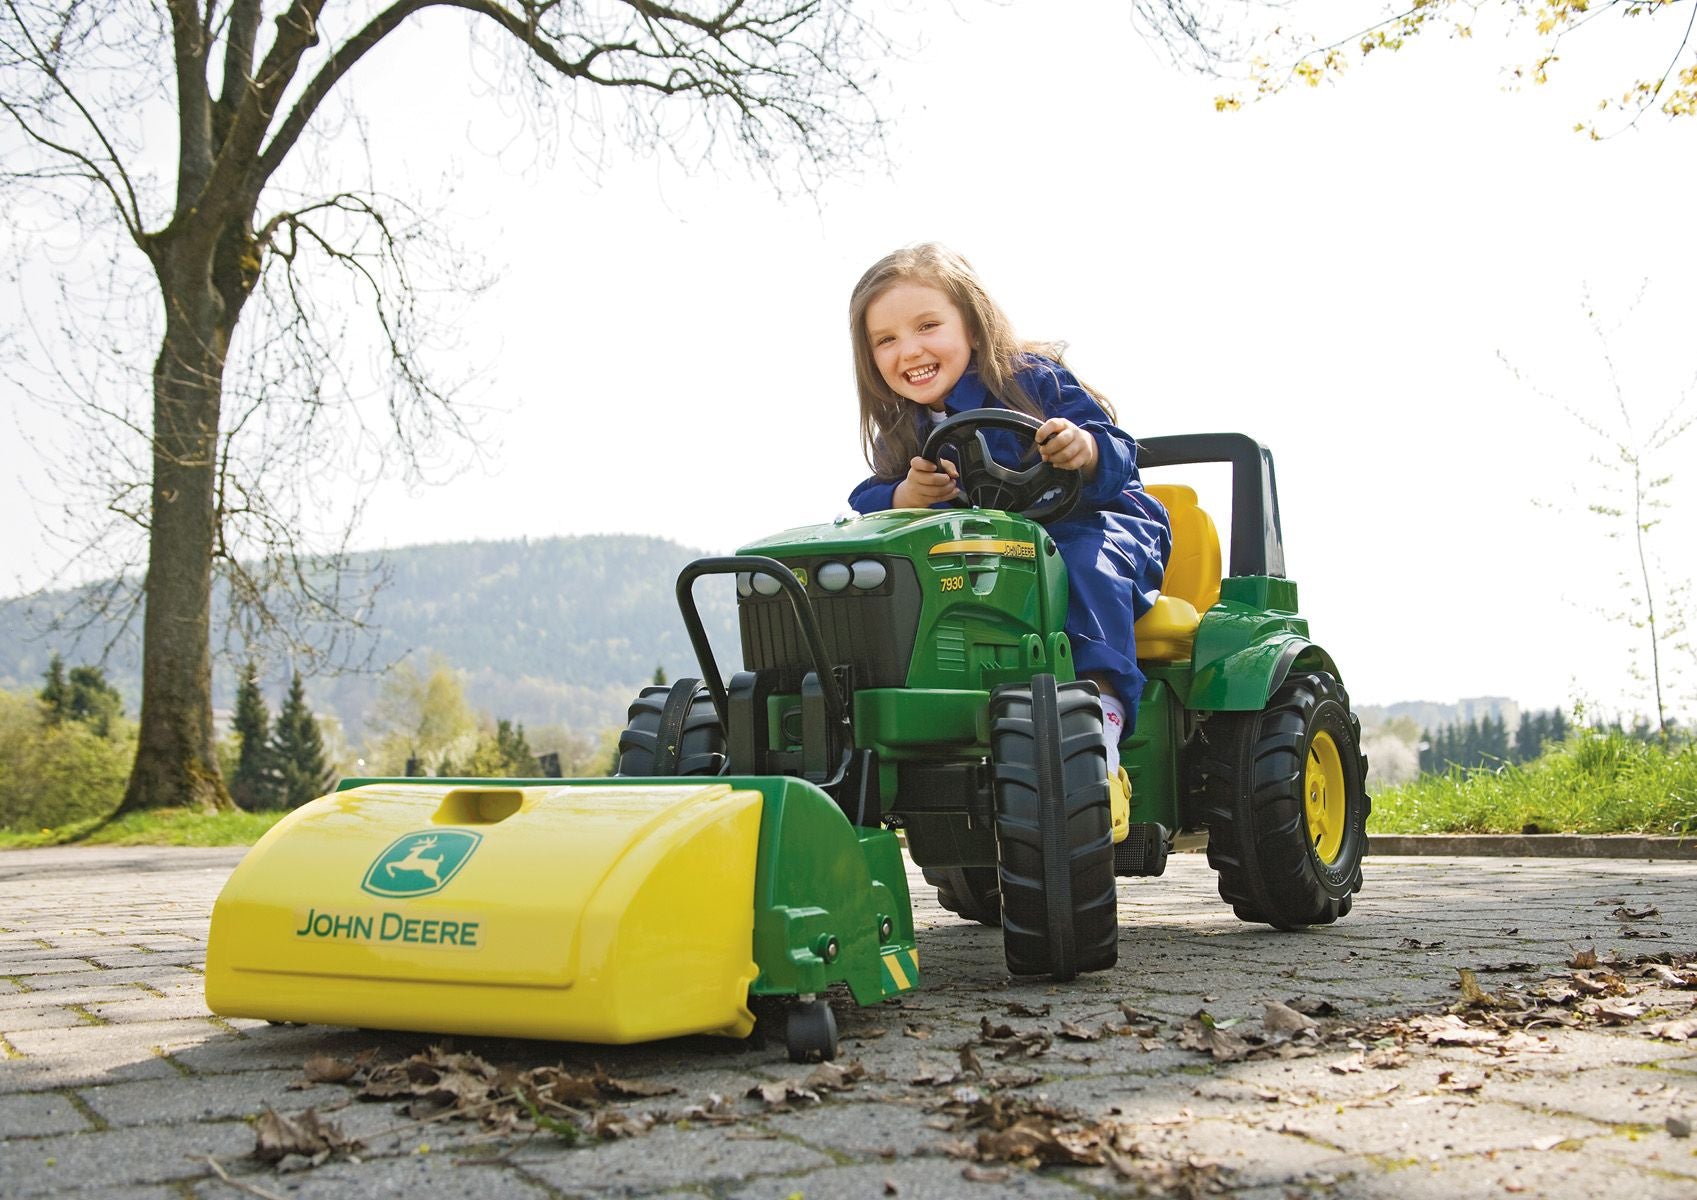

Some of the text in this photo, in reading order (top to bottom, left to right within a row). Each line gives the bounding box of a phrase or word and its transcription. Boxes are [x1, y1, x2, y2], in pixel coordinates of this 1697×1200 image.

[940, 576, 964, 592] 7930
[296, 908, 480, 946] JOHN DEERE
